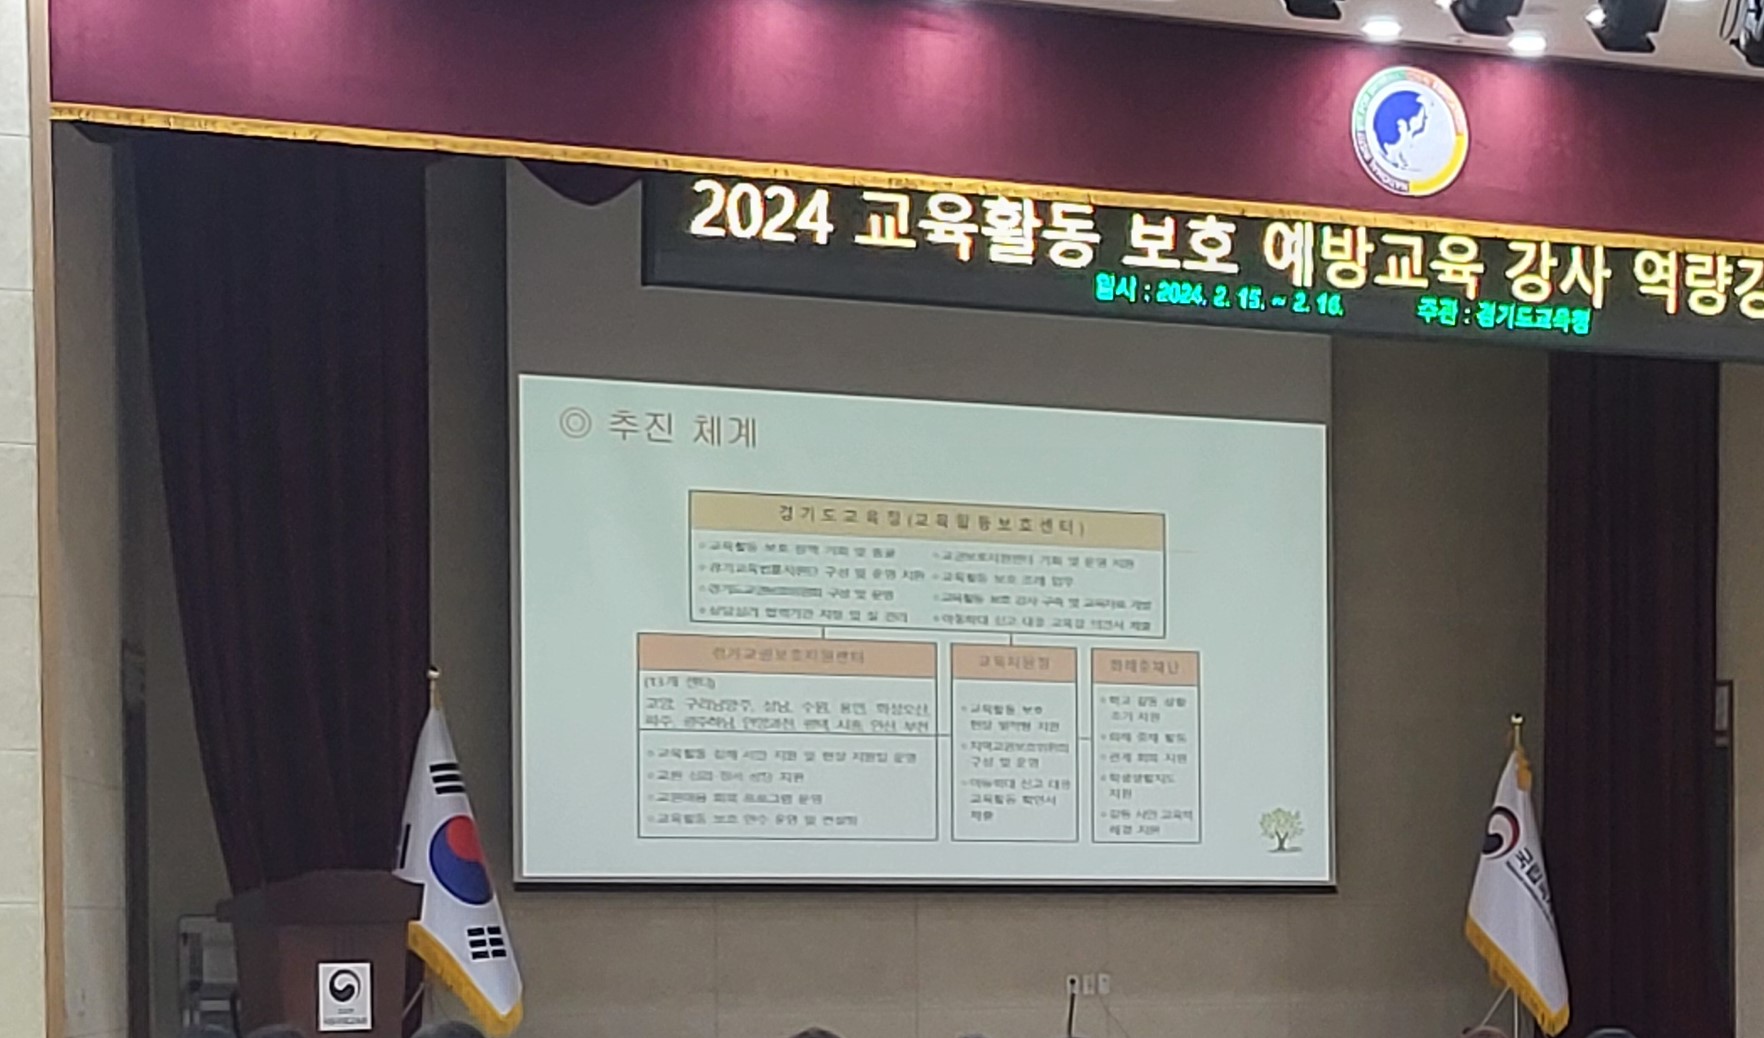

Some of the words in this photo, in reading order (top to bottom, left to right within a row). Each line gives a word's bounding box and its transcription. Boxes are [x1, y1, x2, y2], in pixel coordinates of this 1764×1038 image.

[690, 179, 834, 246] 2024
[854, 189, 1101, 269] 교육활동
[1121, 212, 1240, 274] 보호
[1262, 220, 1485, 304] 예방교육
[1504, 240, 1613, 310] 강사
[1096, 272, 1137, 302] 일시
[1156, 280, 1208, 306] 2024.
[1213, 284, 1231, 308] 2.
[1417, 296, 1459, 326] 주관
[1476, 299, 1593, 335] 경기도교육청
[607, 408, 676, 447] 추진
[693, 414, 760, 450] 체계
